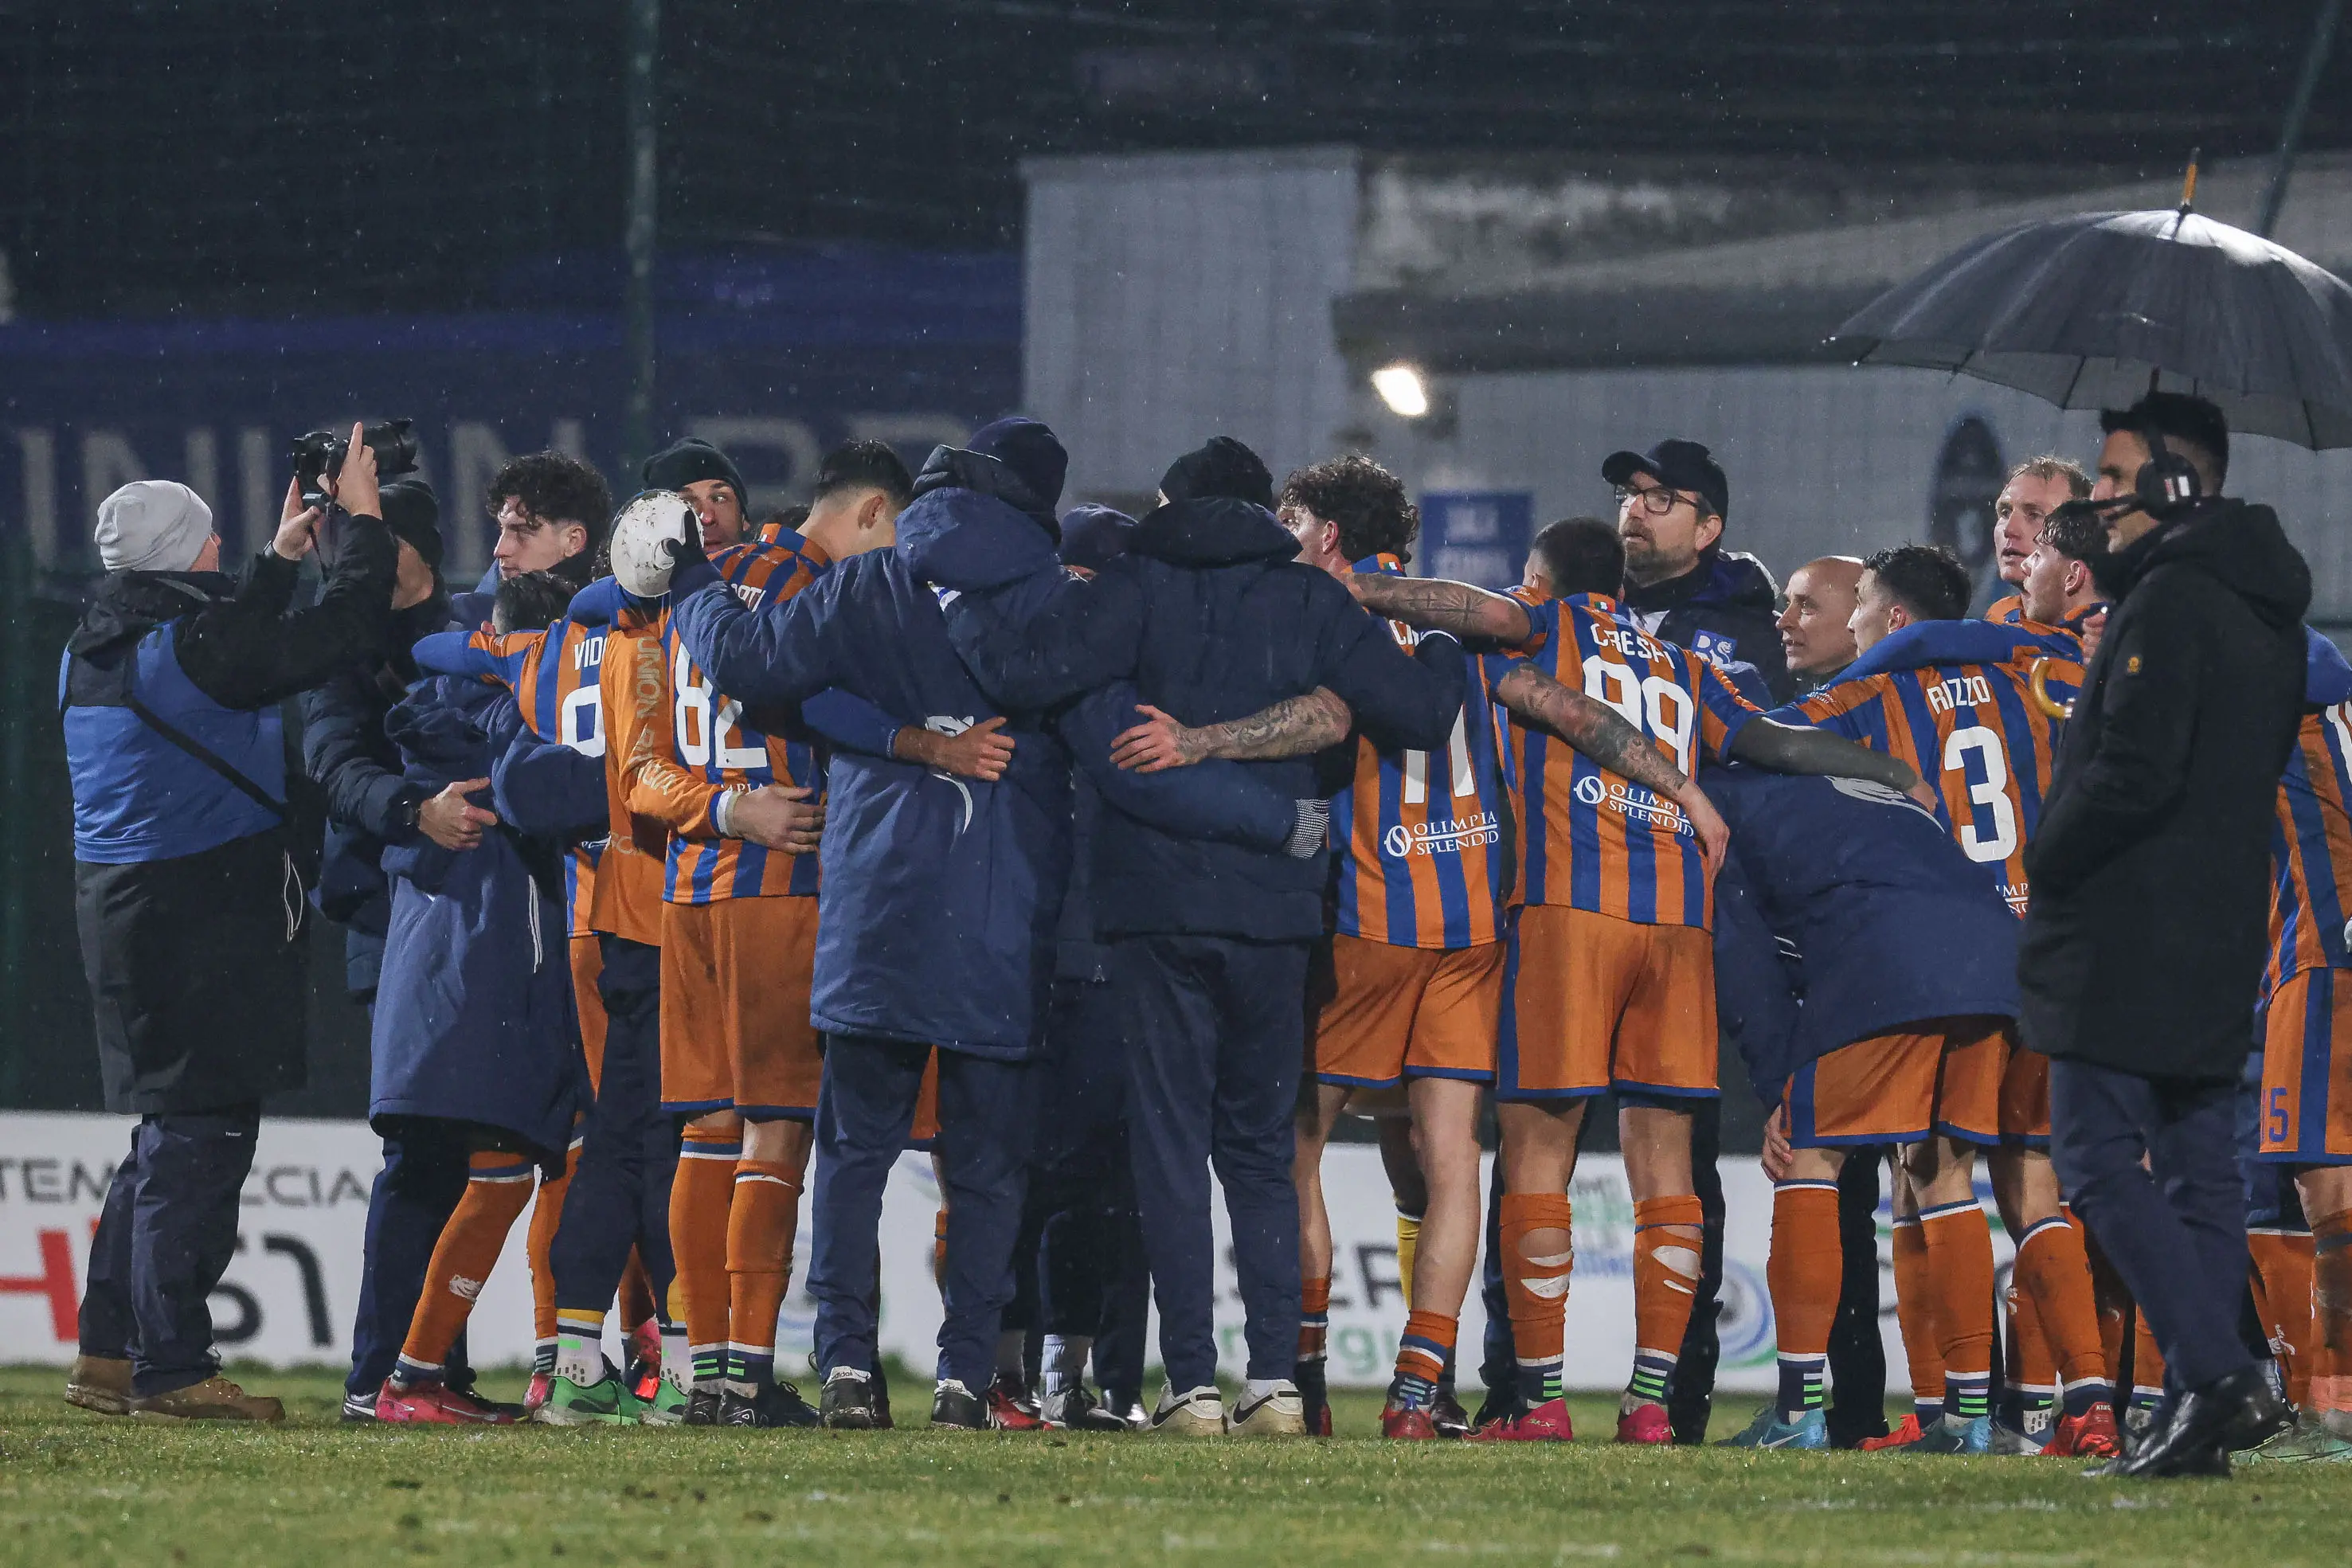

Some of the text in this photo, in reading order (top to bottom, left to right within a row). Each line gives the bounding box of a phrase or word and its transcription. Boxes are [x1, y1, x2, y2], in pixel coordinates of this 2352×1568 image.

[636, 635, 663, 719] UNION
[1926, 675, 1991, 716] RIZZO
[1582, 654, 1694, 777] 99
[1944, 725, 2017, 863] 3
[1413, 811, 1497, 836] OLIMPIA
[1608, 800, 1695, 837] SPLENDID
[1416, 831, 1499, 855] SPLENDID
